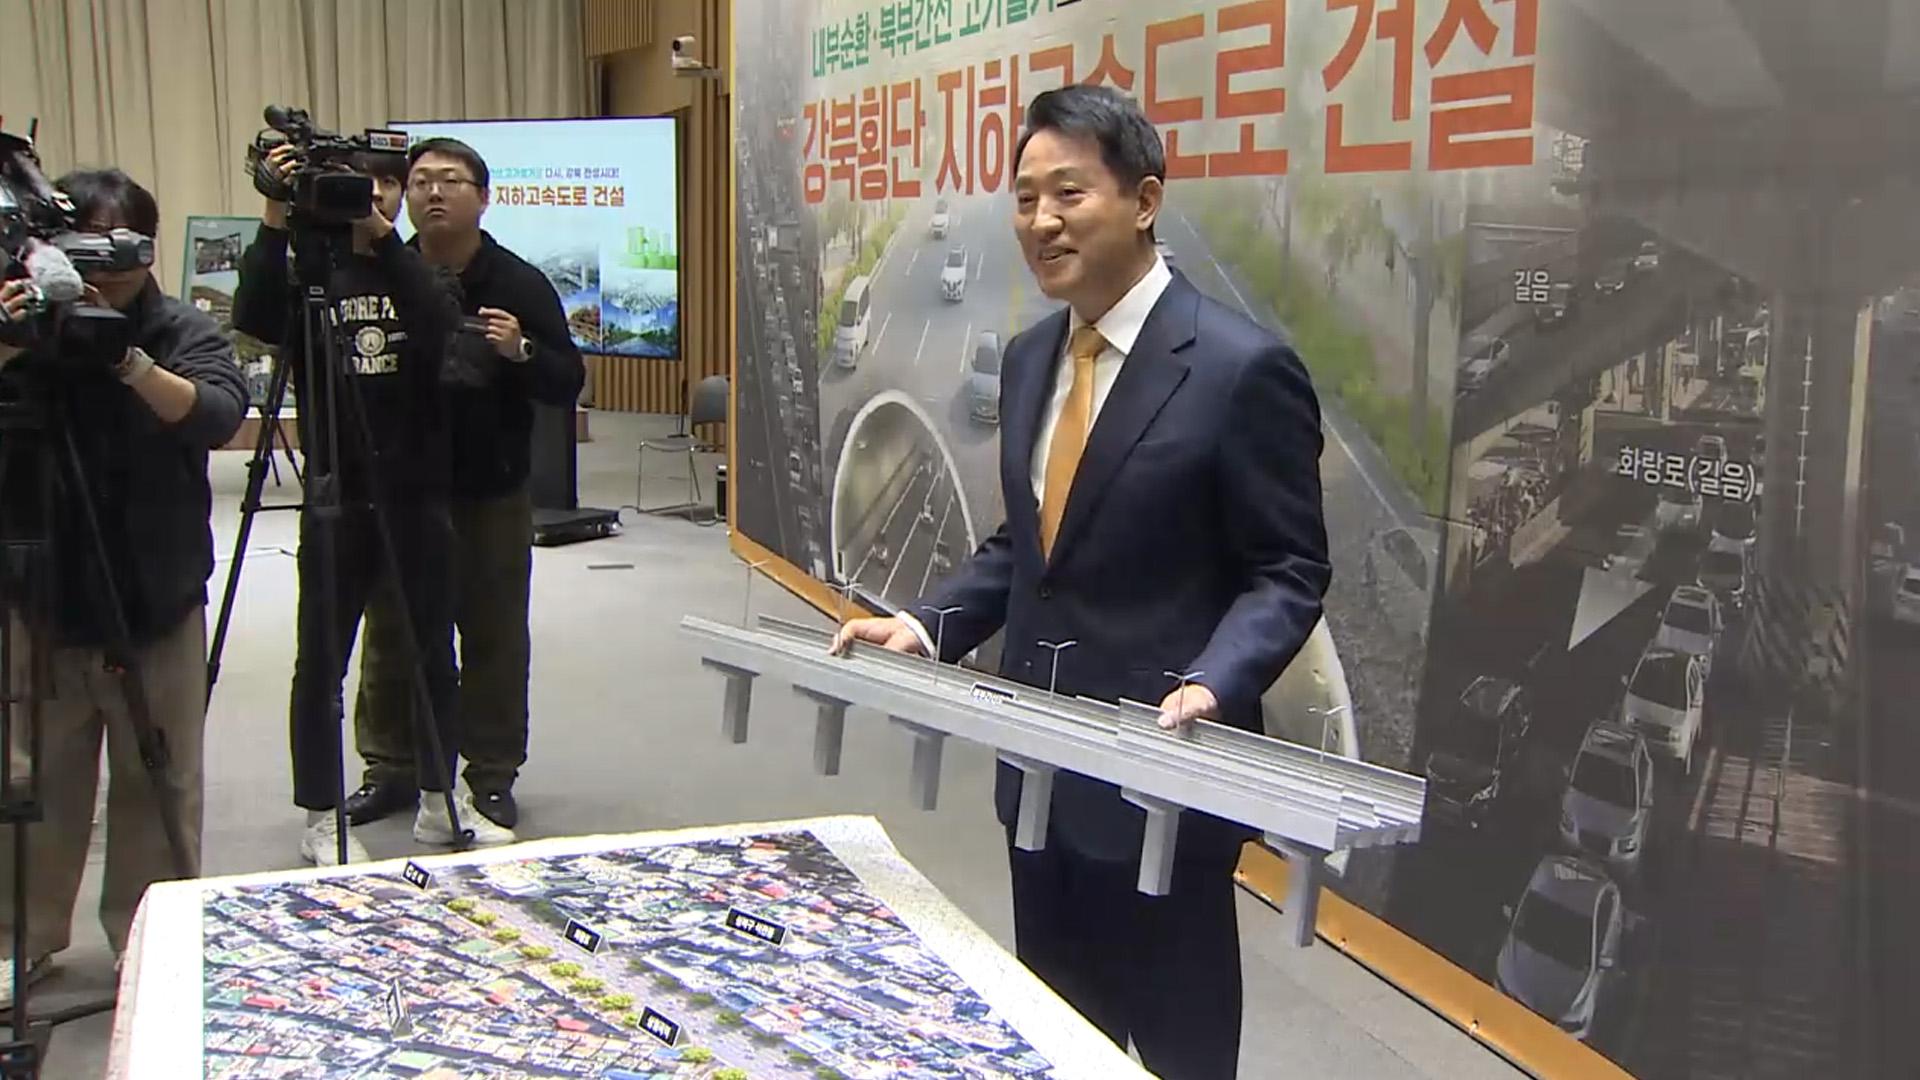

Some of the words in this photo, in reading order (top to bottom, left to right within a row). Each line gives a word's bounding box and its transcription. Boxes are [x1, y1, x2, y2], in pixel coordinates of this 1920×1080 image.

[803, 77, 926, 204] 강북횡단
[1322, 0, 1539, 173] 건설
[496, 186, 587, 206] 지하고속도로
[594, 186, 624, 207] 건설
[1515, 271, 1550, 302] 길음
[1619, 447, 1755, 502] 화랑로(길음)
